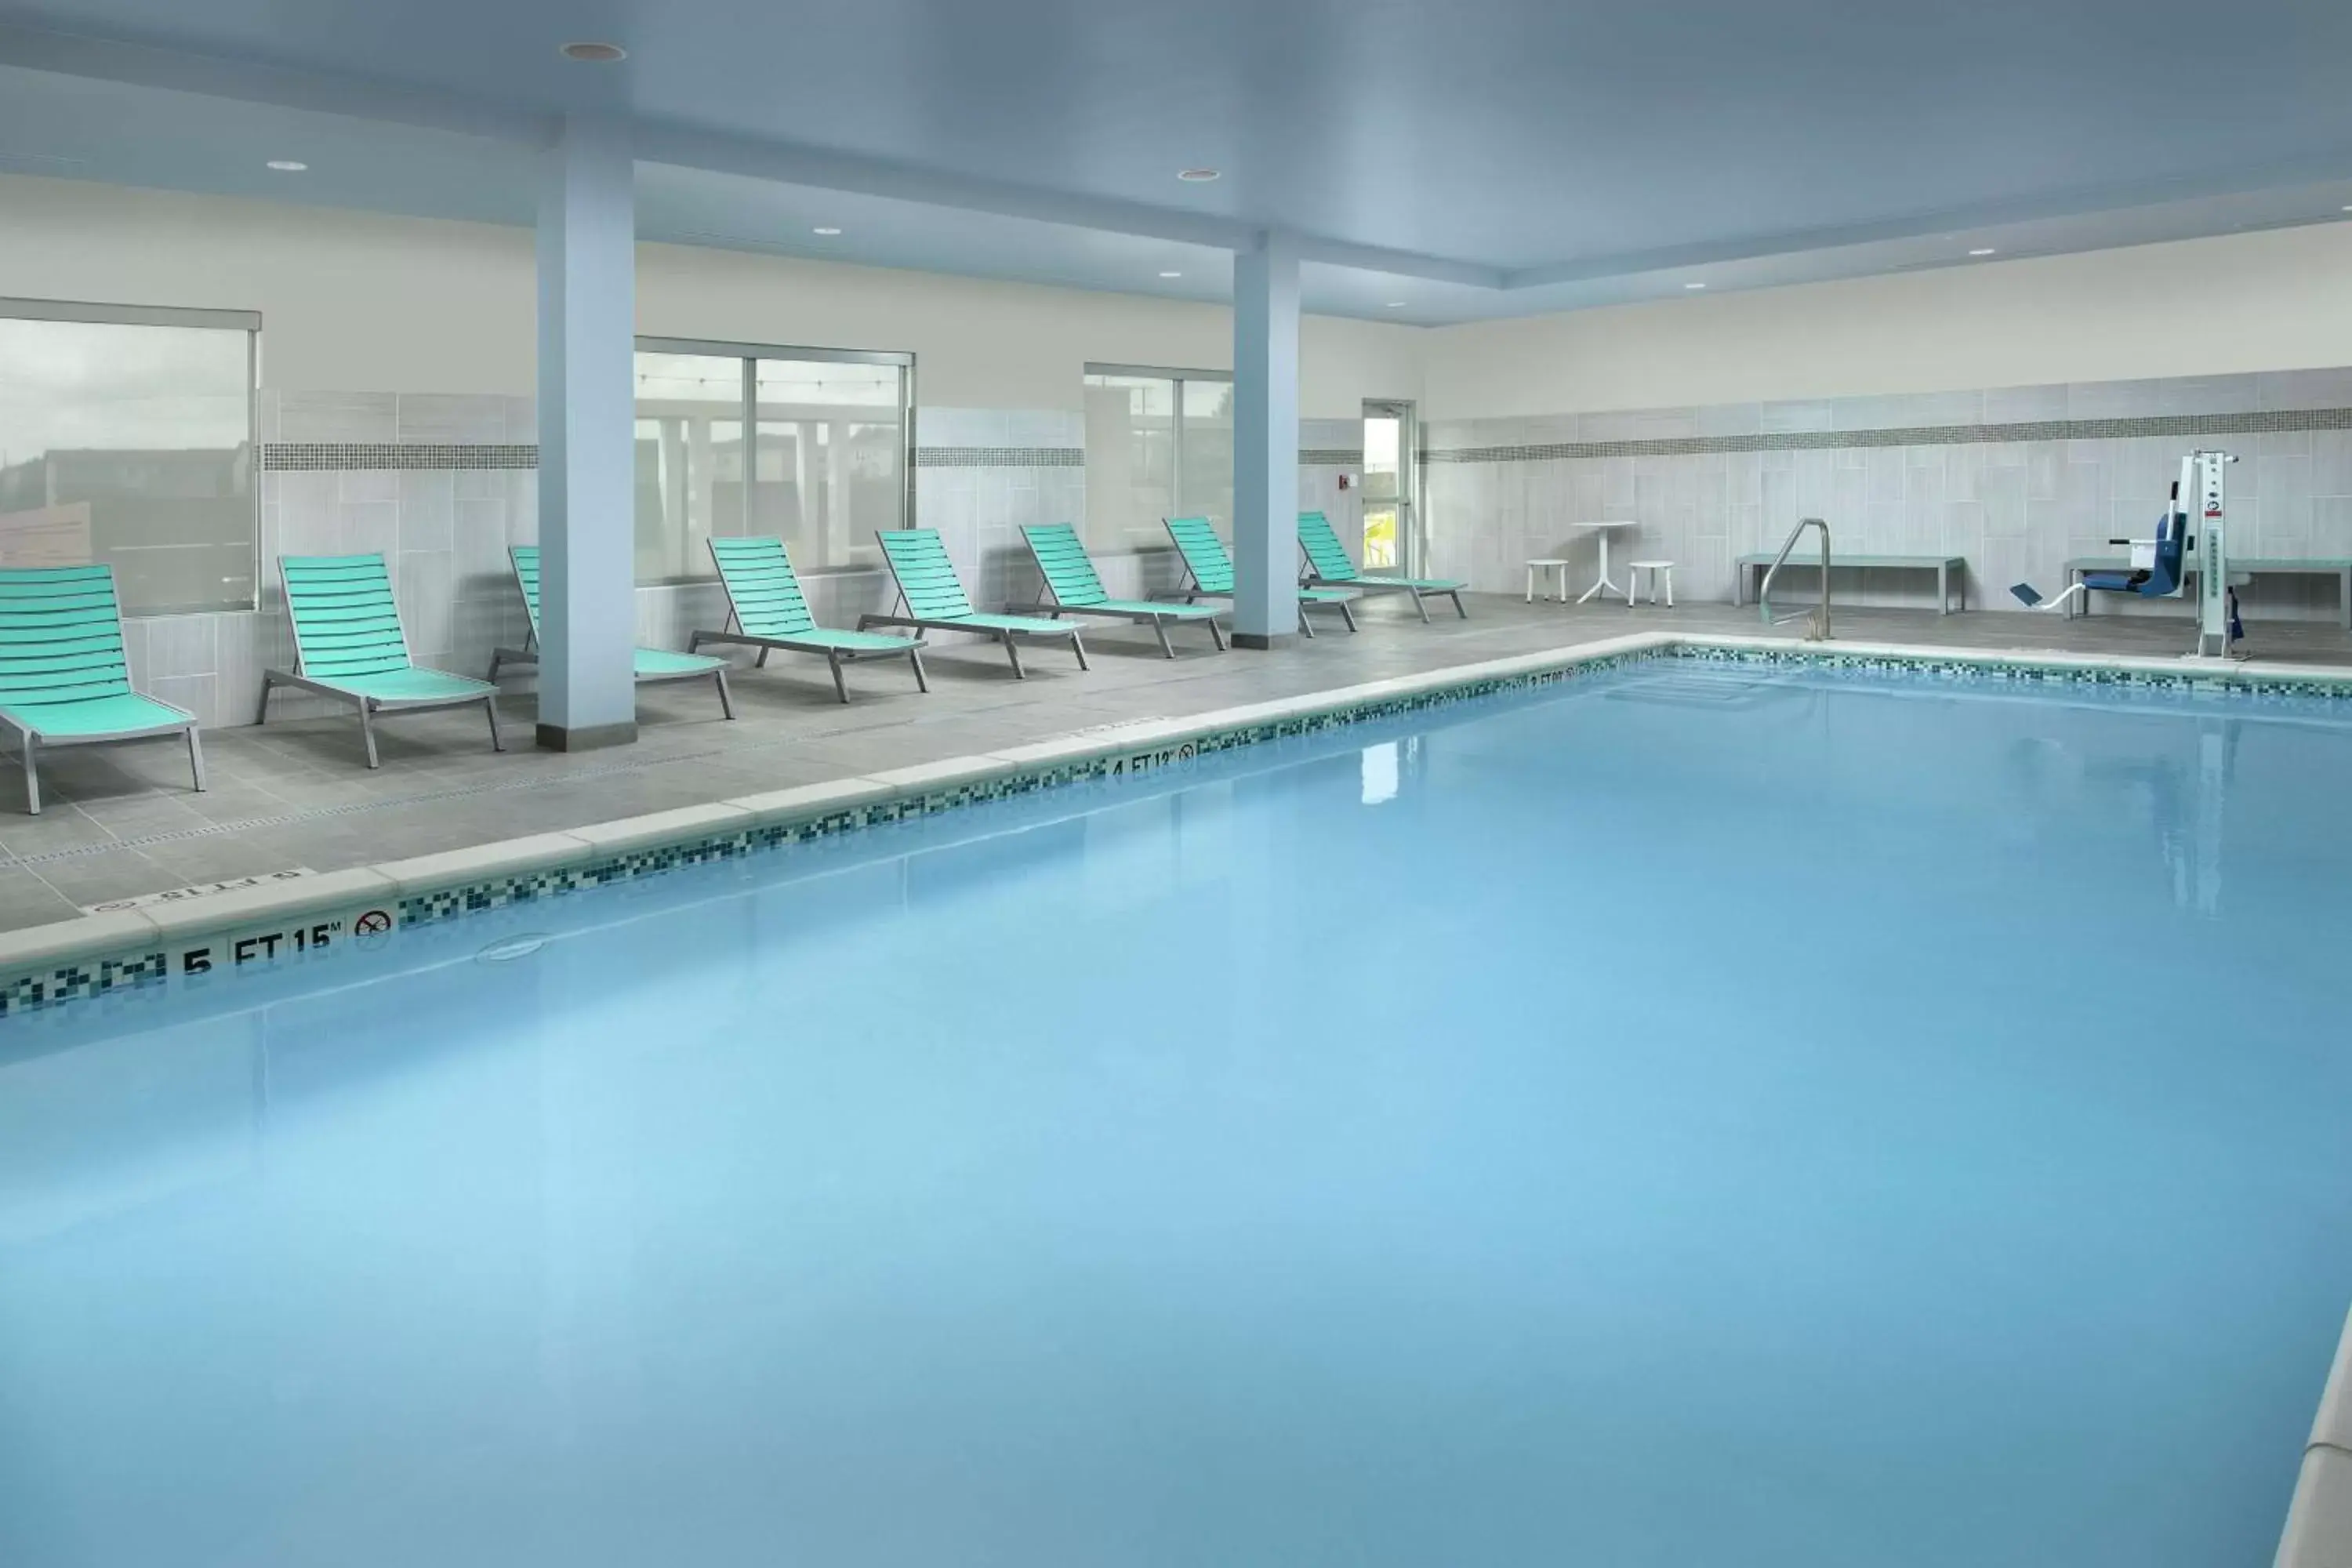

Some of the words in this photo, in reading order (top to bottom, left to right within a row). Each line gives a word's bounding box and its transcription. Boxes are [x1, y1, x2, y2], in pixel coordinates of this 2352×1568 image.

[1132, 753, 1151, 771] FT
[183, 947, 212, 975] 5
[235, 932, 283, 966] FT
